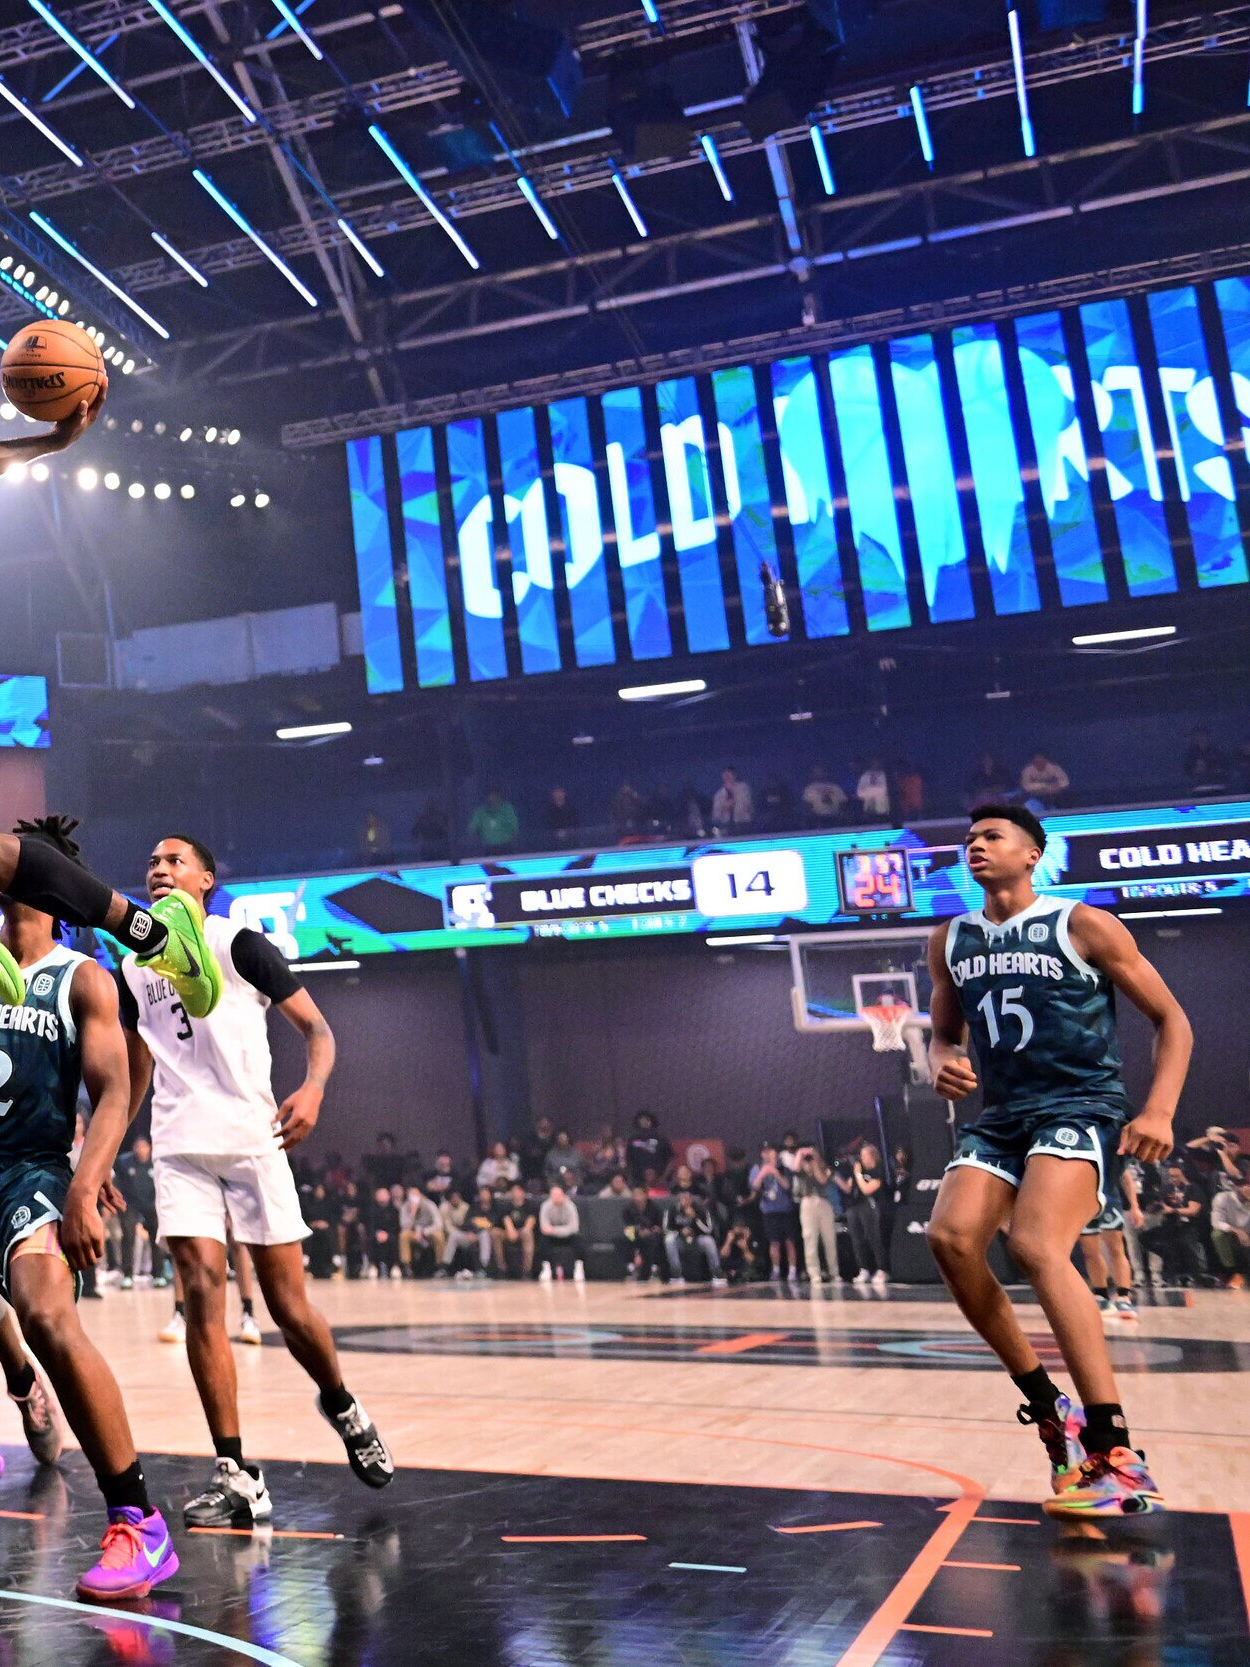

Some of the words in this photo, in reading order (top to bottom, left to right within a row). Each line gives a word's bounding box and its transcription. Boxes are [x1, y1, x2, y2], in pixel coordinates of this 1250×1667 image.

[458, 414, 742, 619] COLD
[1099, 844, 1183, 869] COLD
[1186, 839, 1250, 863] HEA
[520, 887, 586, 912] BLUE
[588, 879, 691, 908] CHECKS
[725, 870, 775, 898] 14
[854, 872, 901, 907] 24
[951, 955, 986, 988] COLD
[989, 951, 1064, 981] HEARTS
[146, 978, 167, 1006] BLUE
[171, 1001, 193, 1040] 3
[976, 985, 1034, 1053] 15
